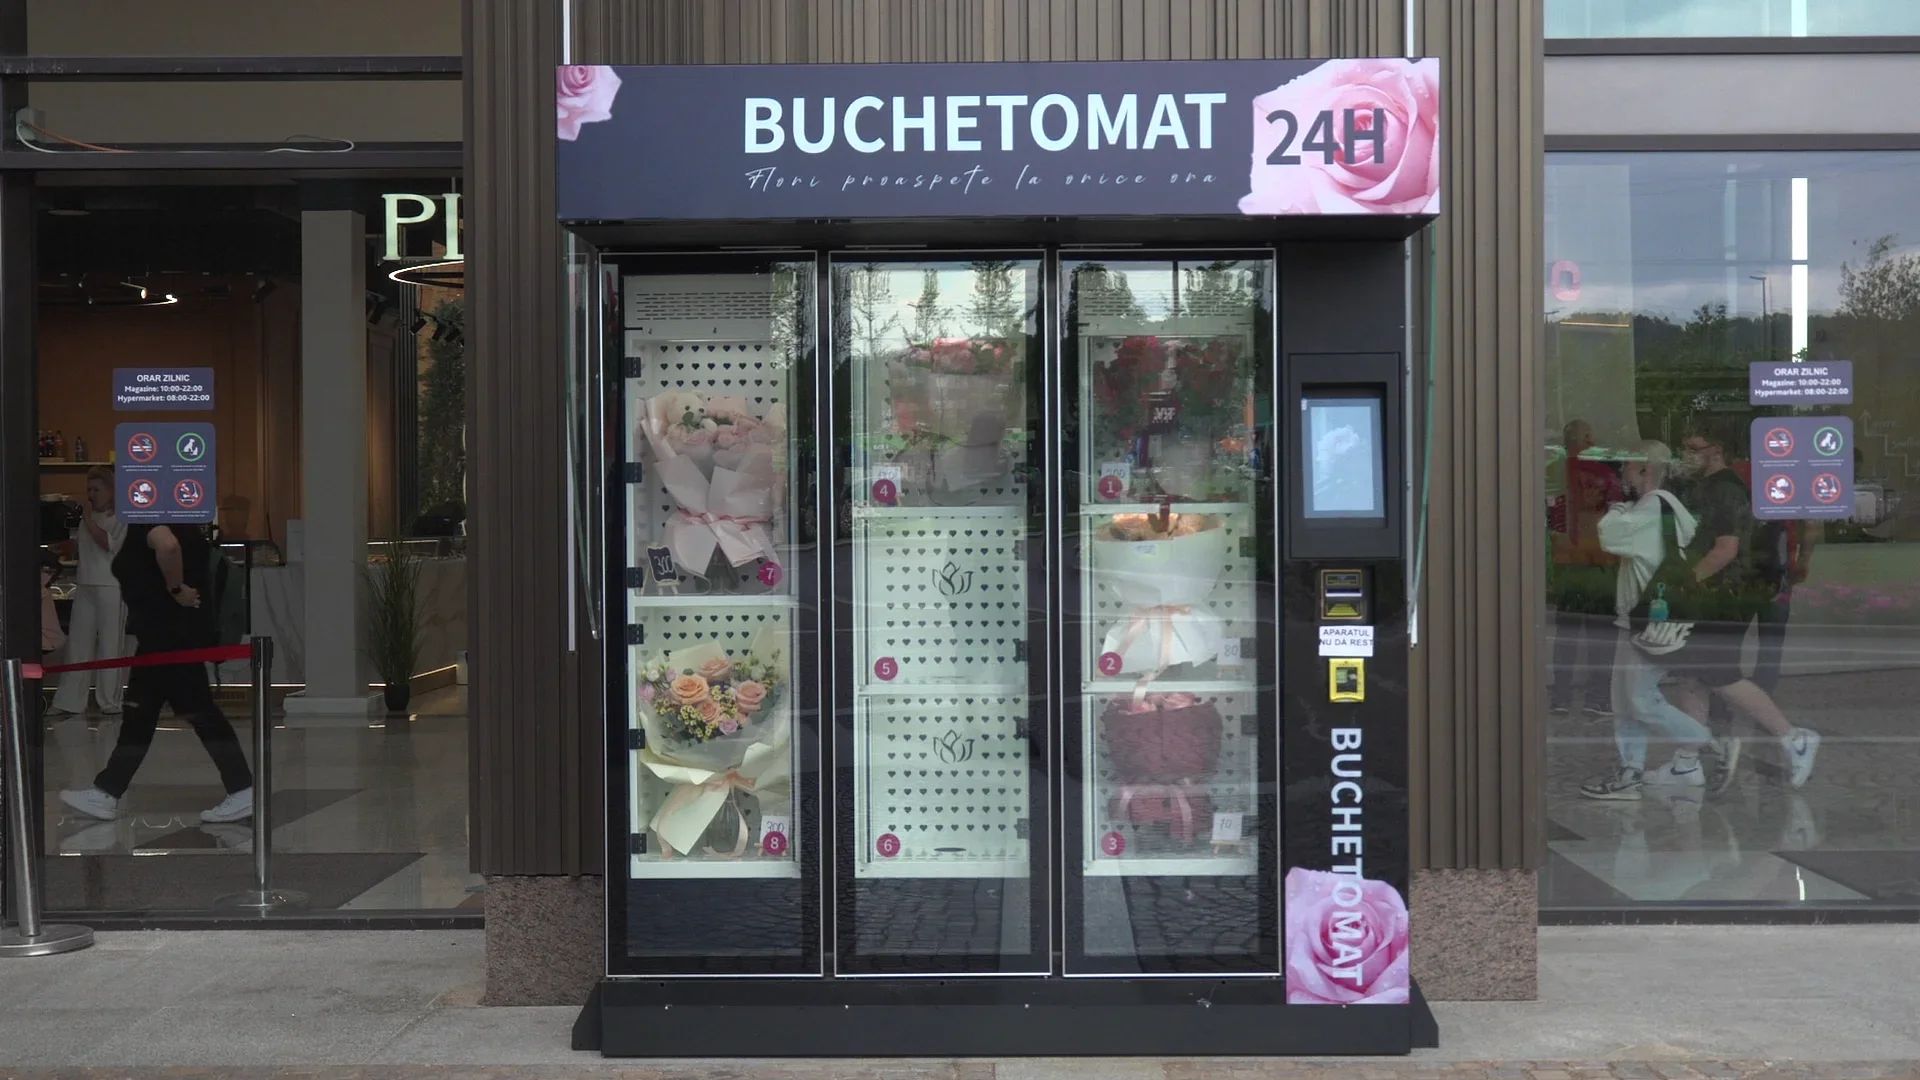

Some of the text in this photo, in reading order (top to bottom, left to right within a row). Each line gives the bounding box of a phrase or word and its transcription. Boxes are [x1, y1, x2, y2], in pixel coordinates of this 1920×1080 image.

[744, 93, 1227, 154] BUCHETOMAT
[1265, 107, 1386, 166] 24H
[744, 164, 1218, 194] Flori proaspete la orice ora
[1773, 366, 1829, 377] ORAR ZILNIC
[136, 374, 191, 383] ORAR ZILNIC
[1761, 378, 1842, 388] Magazine: 10:00-22:00
[124, 384, 204, 394] Magazine: 10:00-22:00
[1754, 387, 1849, 398] Hypermarket: 08:00-22:00
[117, 394, 210, 404] Hypermarket: 08:00-22:00
[879, 484, 889, 498] 4
[1106, 480, 1115, 494] 1
[765, 567, 775, 581] 7
[1322, 628, 1370, 637] APARATUL
[1640, 621, 1695, 648] NIKE
[1319, 638, 1332, 646] NU
[1350, 638, 1374, 647] REST
[882, 662, 891, 676] 5
[1106, 657, 1116, 670] 2
[770, 836, 779, 850] 8
[883, 839, 893, 852] 6
[1108, 837, 1118, 850] 3
[1330, 728, 1363, 986] BUCHETOMAT
